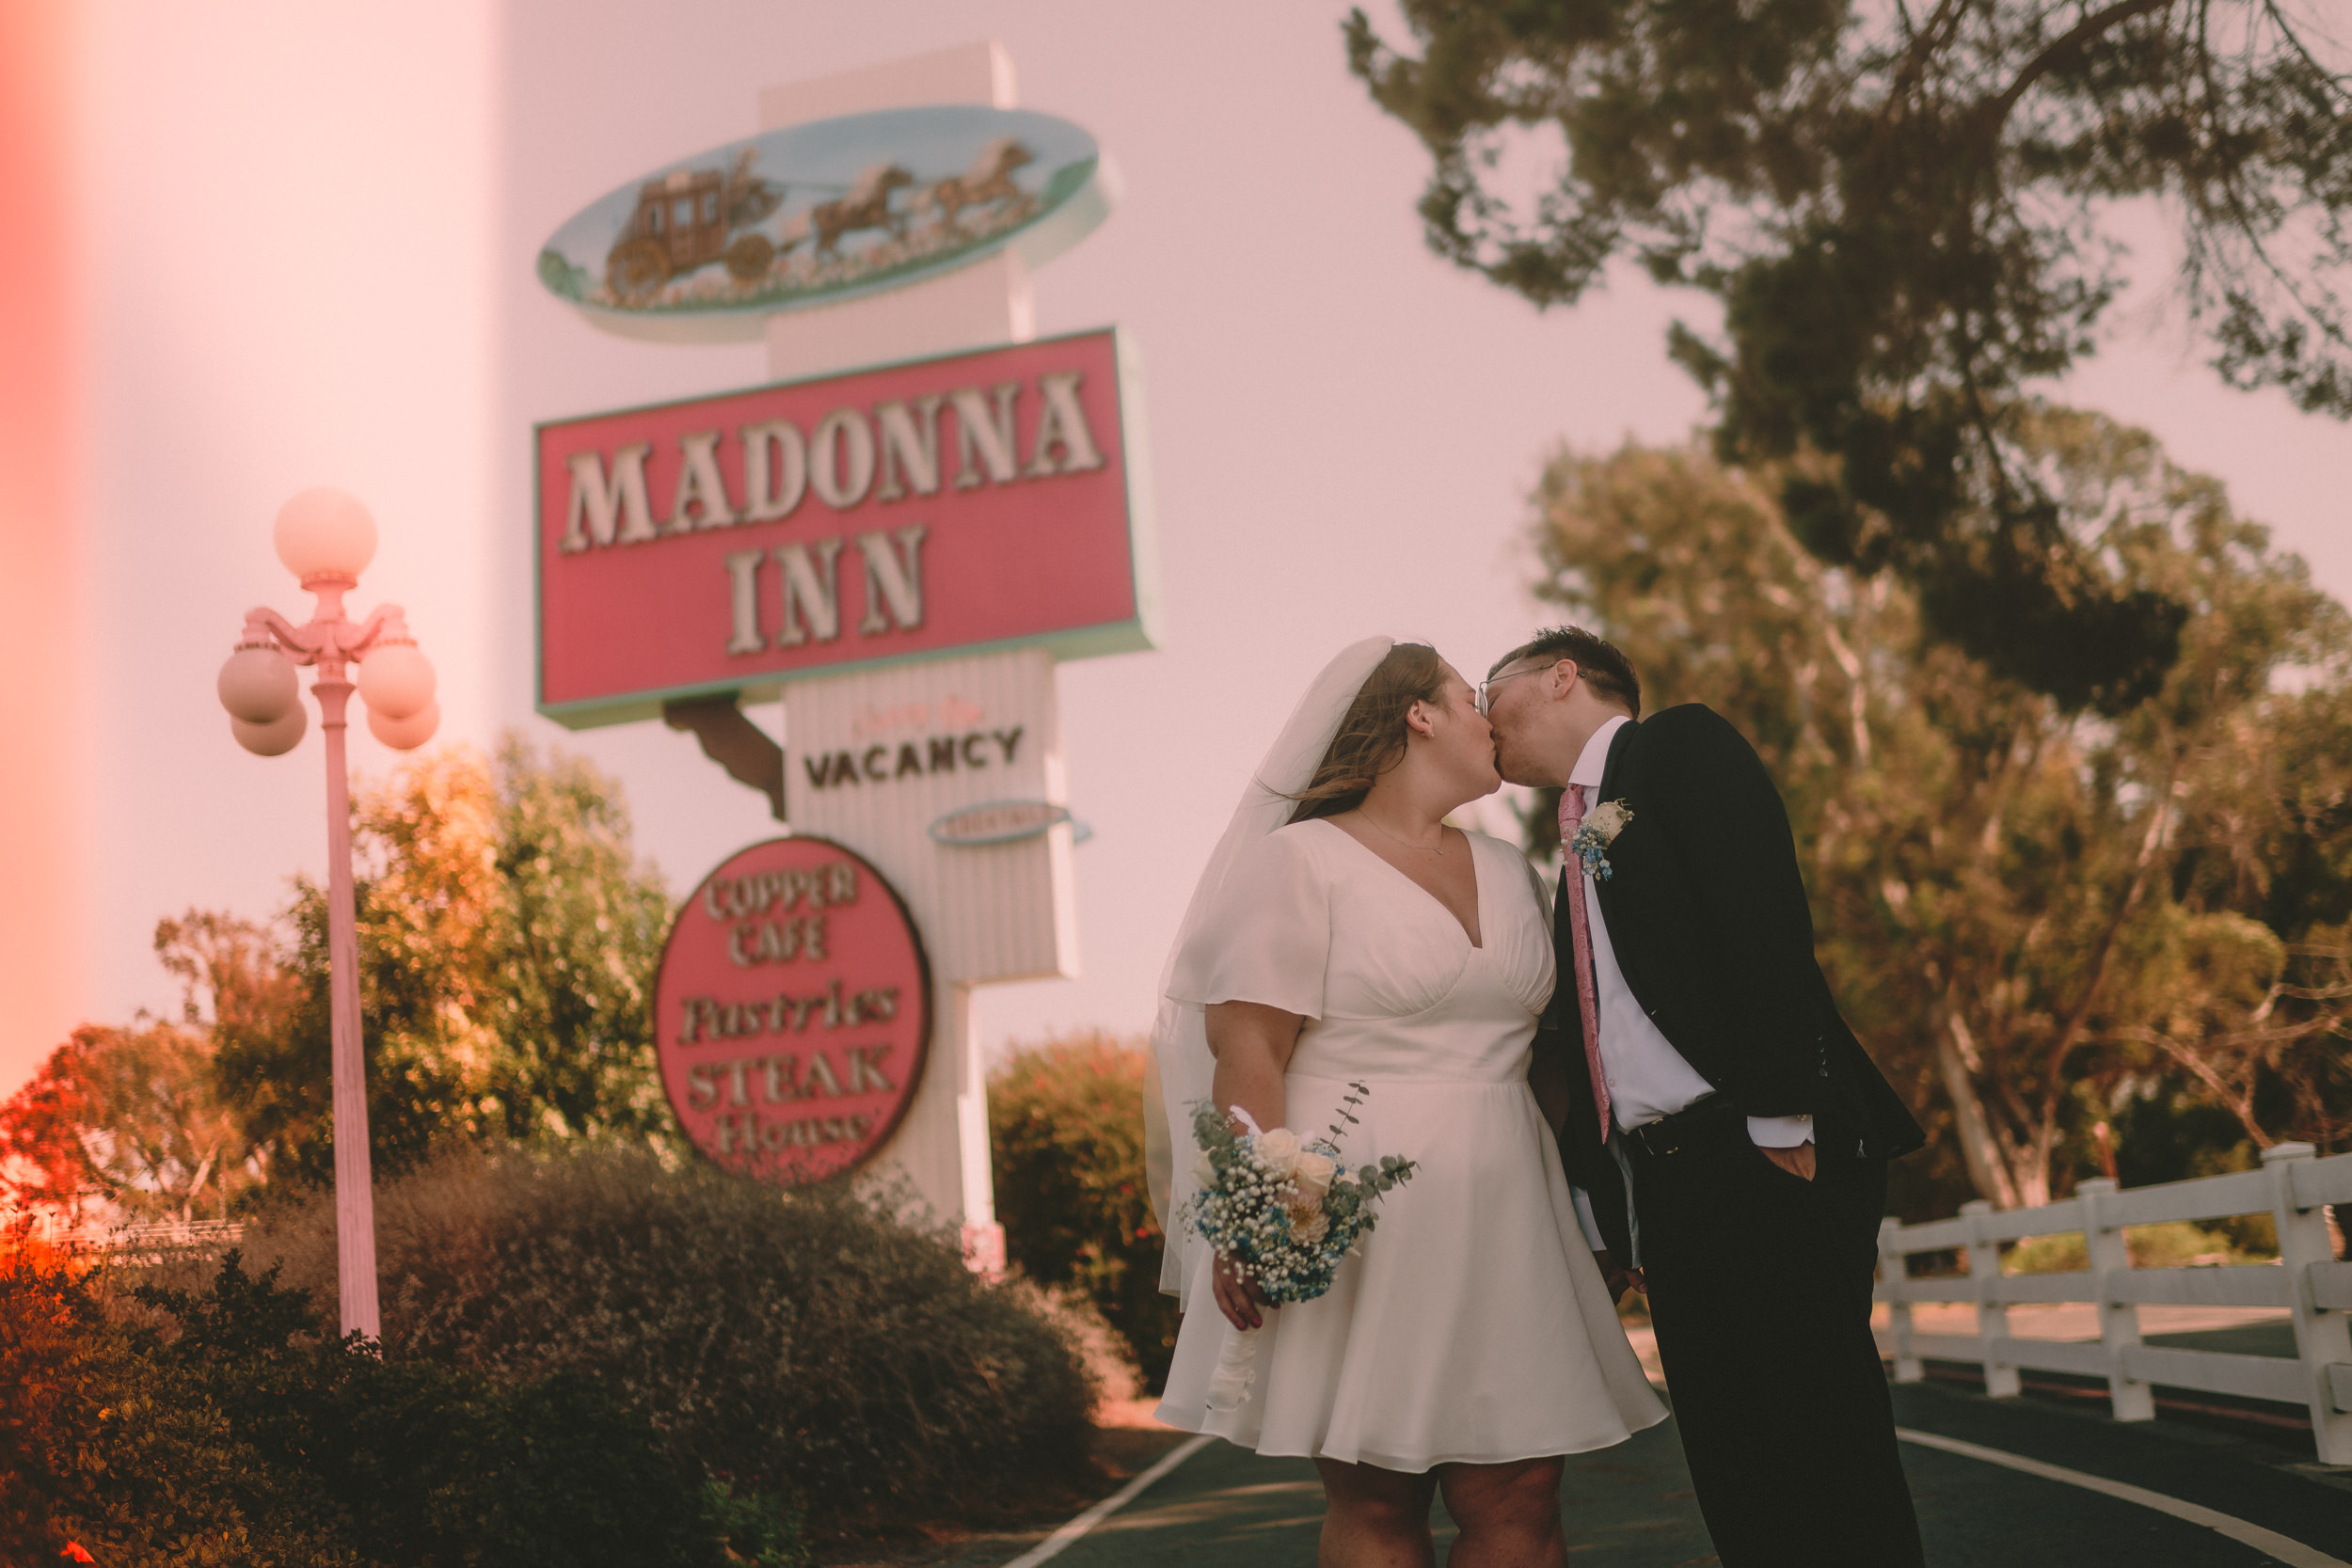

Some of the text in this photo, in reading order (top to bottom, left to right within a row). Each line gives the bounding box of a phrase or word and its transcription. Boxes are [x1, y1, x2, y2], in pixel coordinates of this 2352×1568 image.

[561, 372, 1106, 552] MADONNA
[724, 525, 928, 654] INN
[803, 725, 1024, 789] VACANCY
[703, 862, 856, 920] COPPER
[679, 981, 898, 1044] Pastries
[688, 1045, 895, 1111] STEAK
[716, 1110, 873, 1154] House
